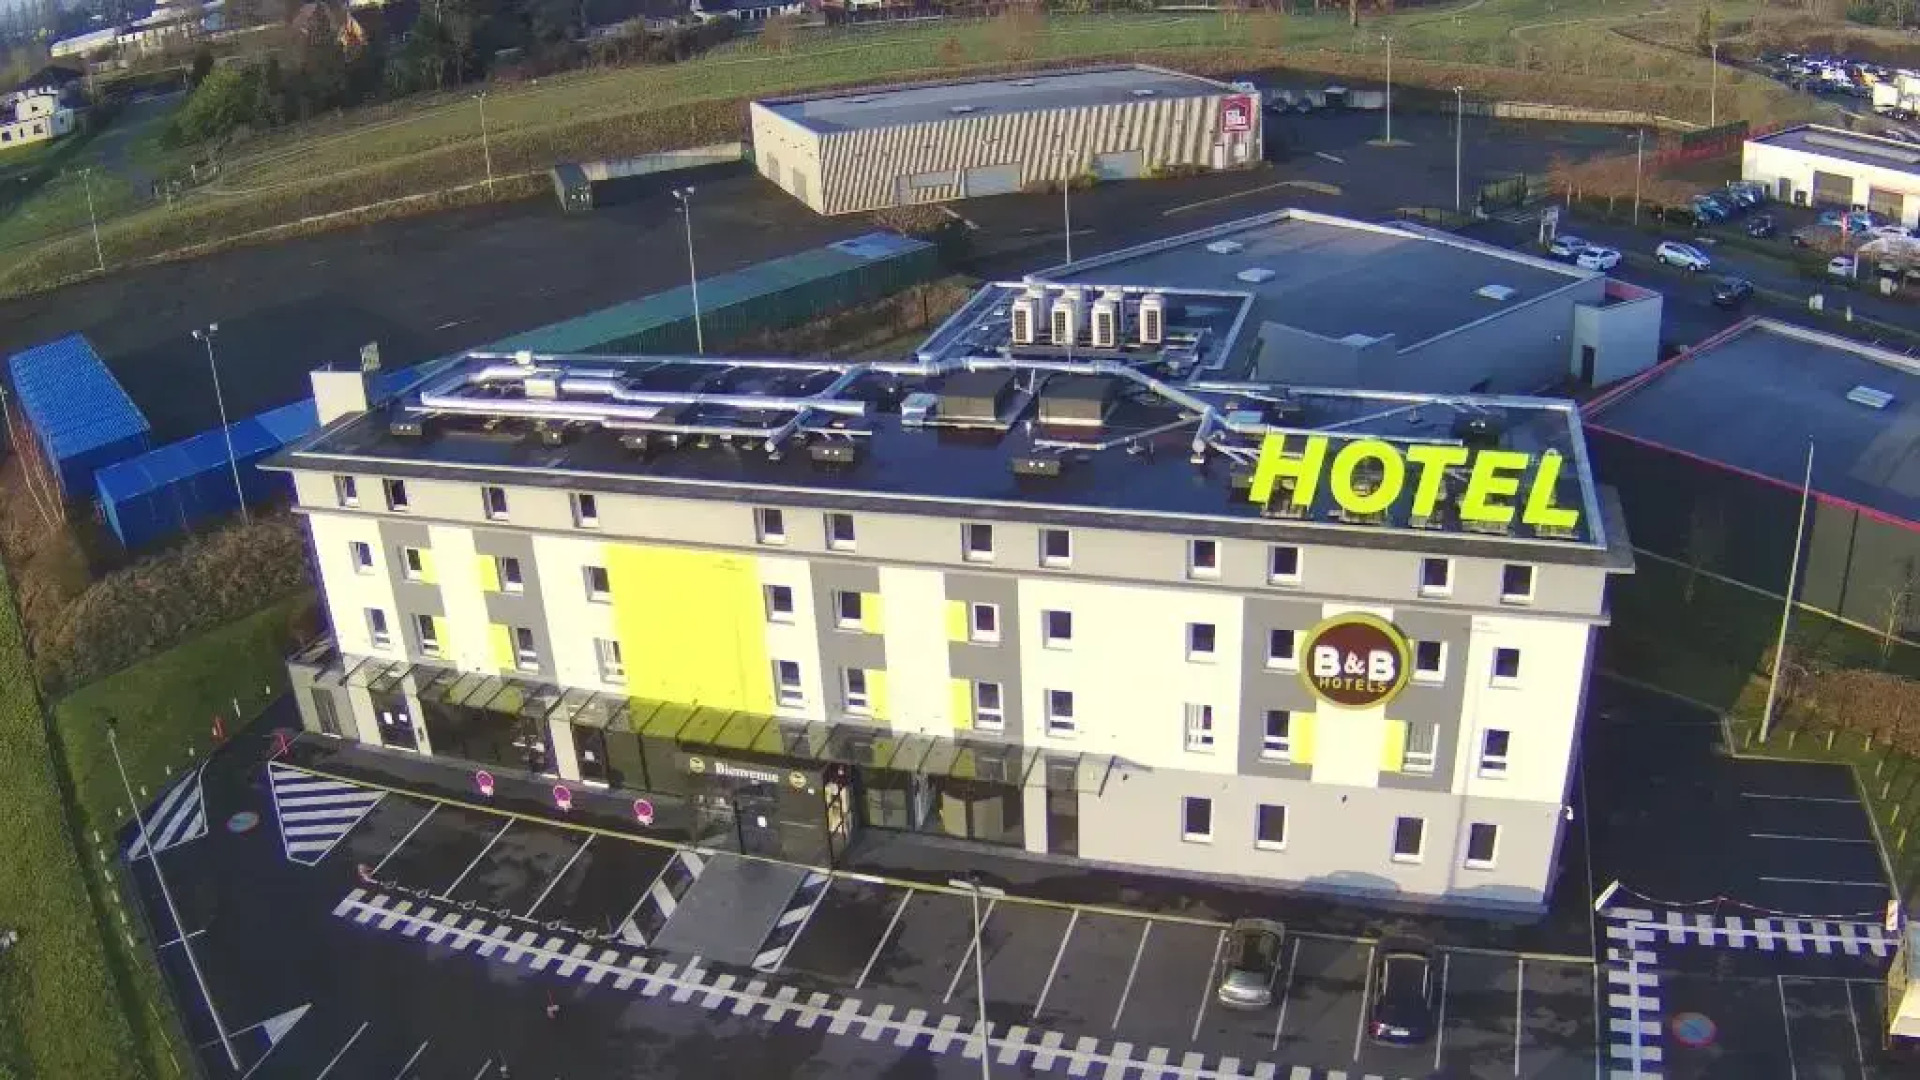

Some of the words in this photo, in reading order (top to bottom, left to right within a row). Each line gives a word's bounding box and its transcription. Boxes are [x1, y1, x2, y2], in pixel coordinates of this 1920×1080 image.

[1249, 434, 1579, 527] HOTEL
[1314, 645, 1395, 681] B&B
[1320, 677, 1386, 692] HOTELS
[715, 761, 779, 783] Bienvenue
